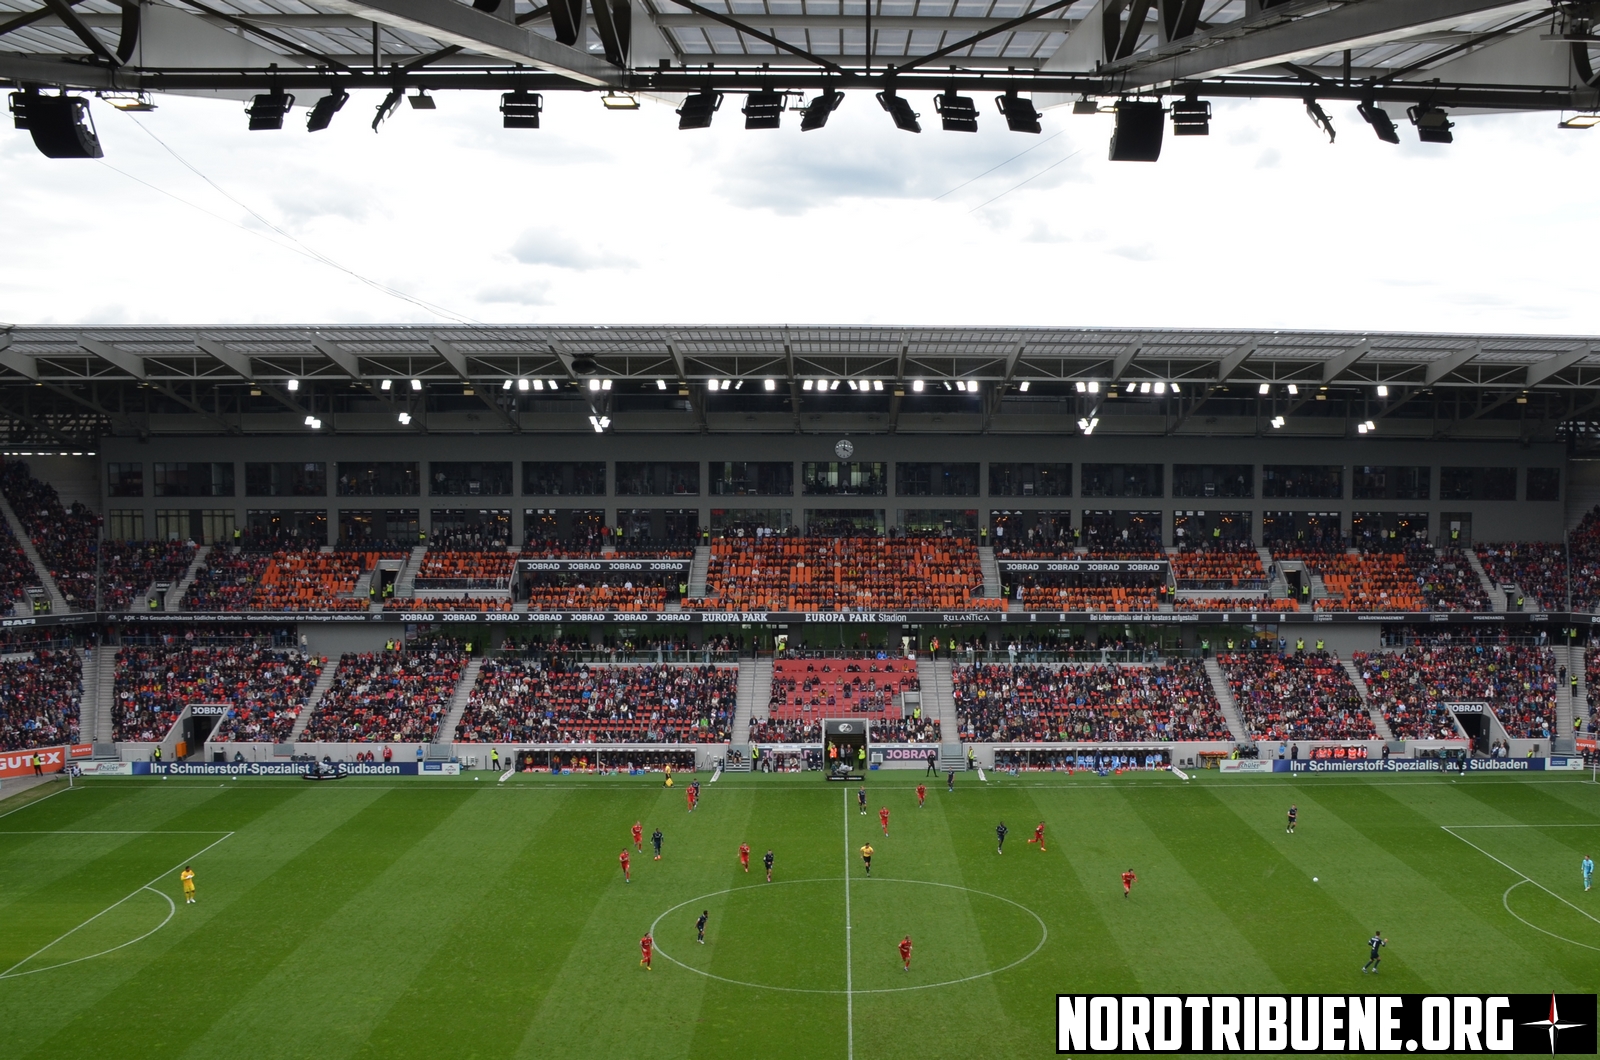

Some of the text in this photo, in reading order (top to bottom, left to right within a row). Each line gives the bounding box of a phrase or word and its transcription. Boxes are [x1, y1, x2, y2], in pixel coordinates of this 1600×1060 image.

[400, 613, 691, 621] JOBRAD JOBRAD JOBRAD JOBRAD JOBRAD JOBRAD JOBRAD
[702, 613, 768, 622] EUROPA PARK
[805, 613, 907, 622] EUROPA PARK Stadion
[943, 613, 990, 621] RULANTICA
[886, 749, 936, 760] JOBRAD
[150, 763, 167, 774] Ihr
[170, 763, 310, 776] Schmierstoff-Spezialist
[338, 763, 400, 775] Südbaden
[1290, 760, 1306, 771] Ihr
[1470, 759, 1528, 770] Südbaden
